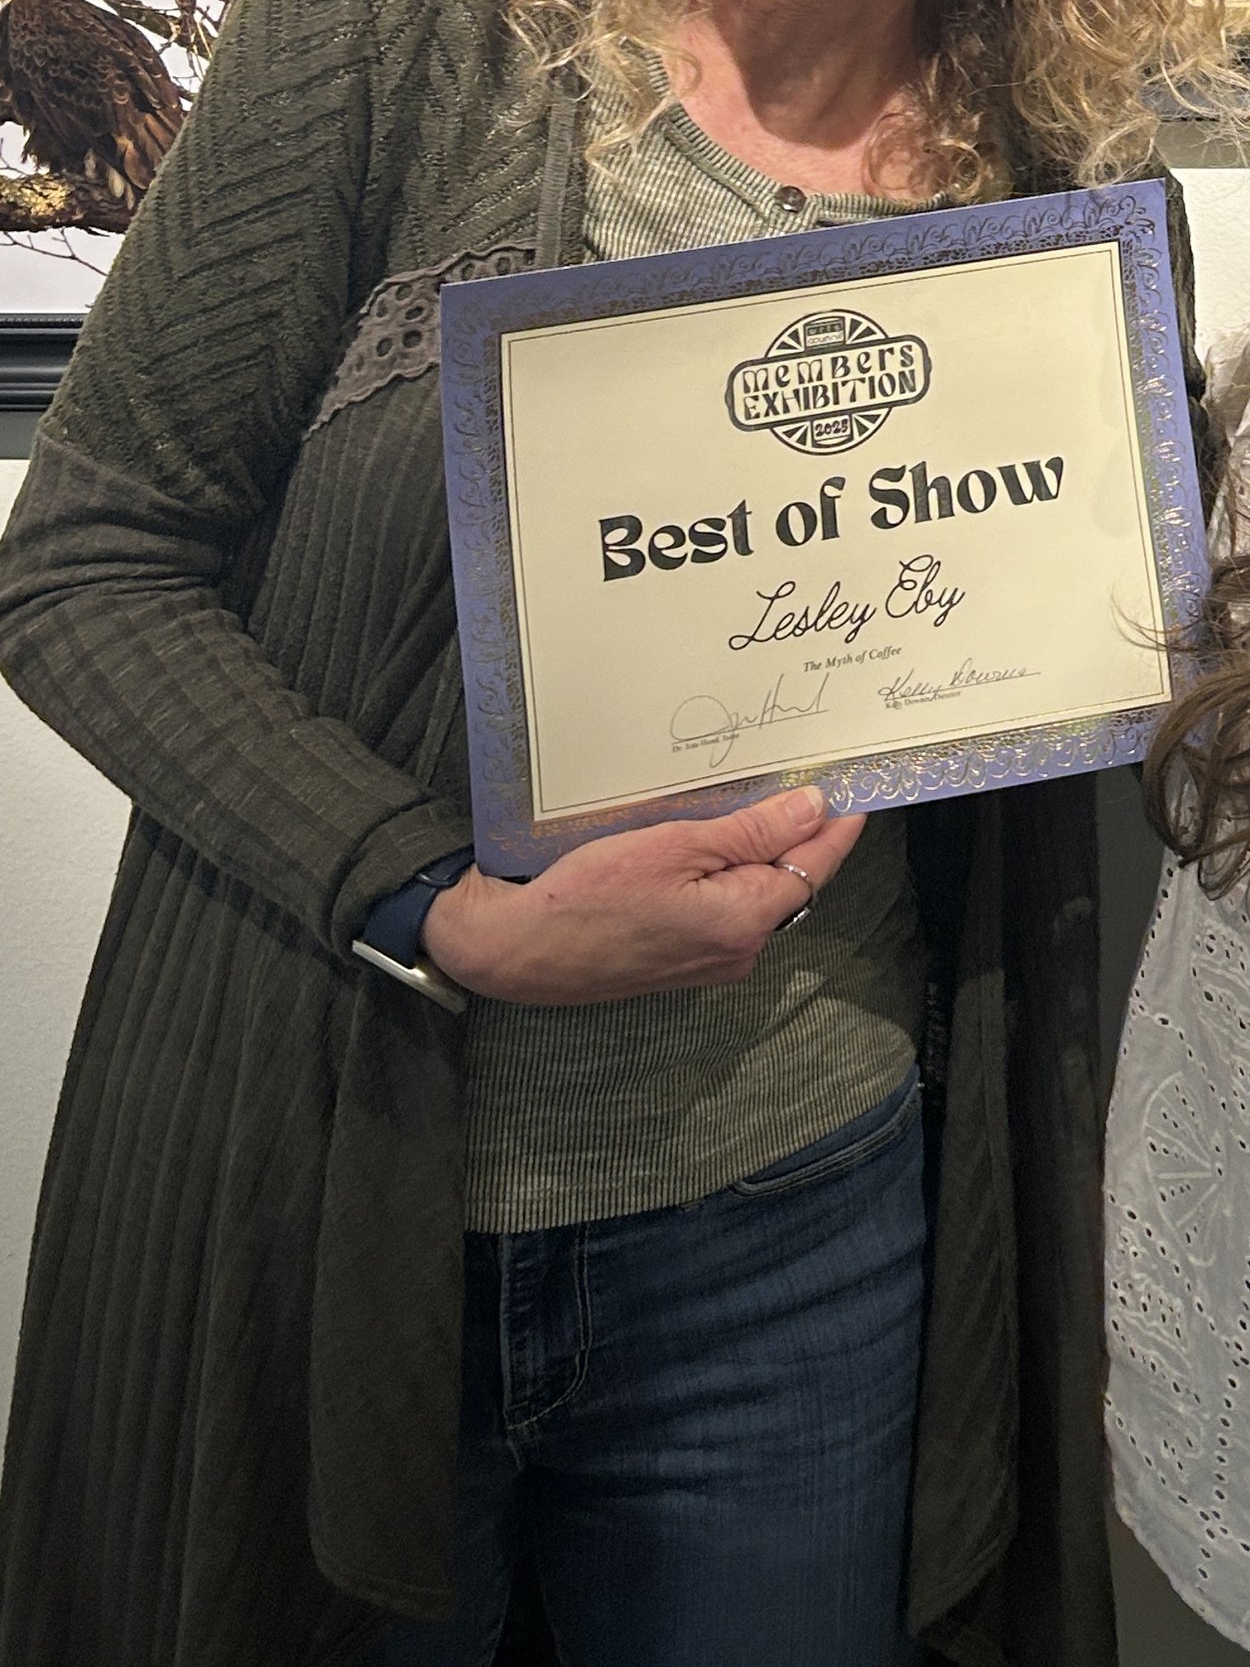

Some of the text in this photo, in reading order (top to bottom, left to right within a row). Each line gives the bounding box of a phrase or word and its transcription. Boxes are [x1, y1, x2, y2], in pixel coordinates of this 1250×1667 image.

[743, 369, 918, 421] EXHIBITION
[814, 418, 849, 438] 2025
[599, 456, 1065, 582] Best of Show
[728, 554, 966, 651] Lesley Eby
[803, 645, 903, 673] The Myth of Coffee
